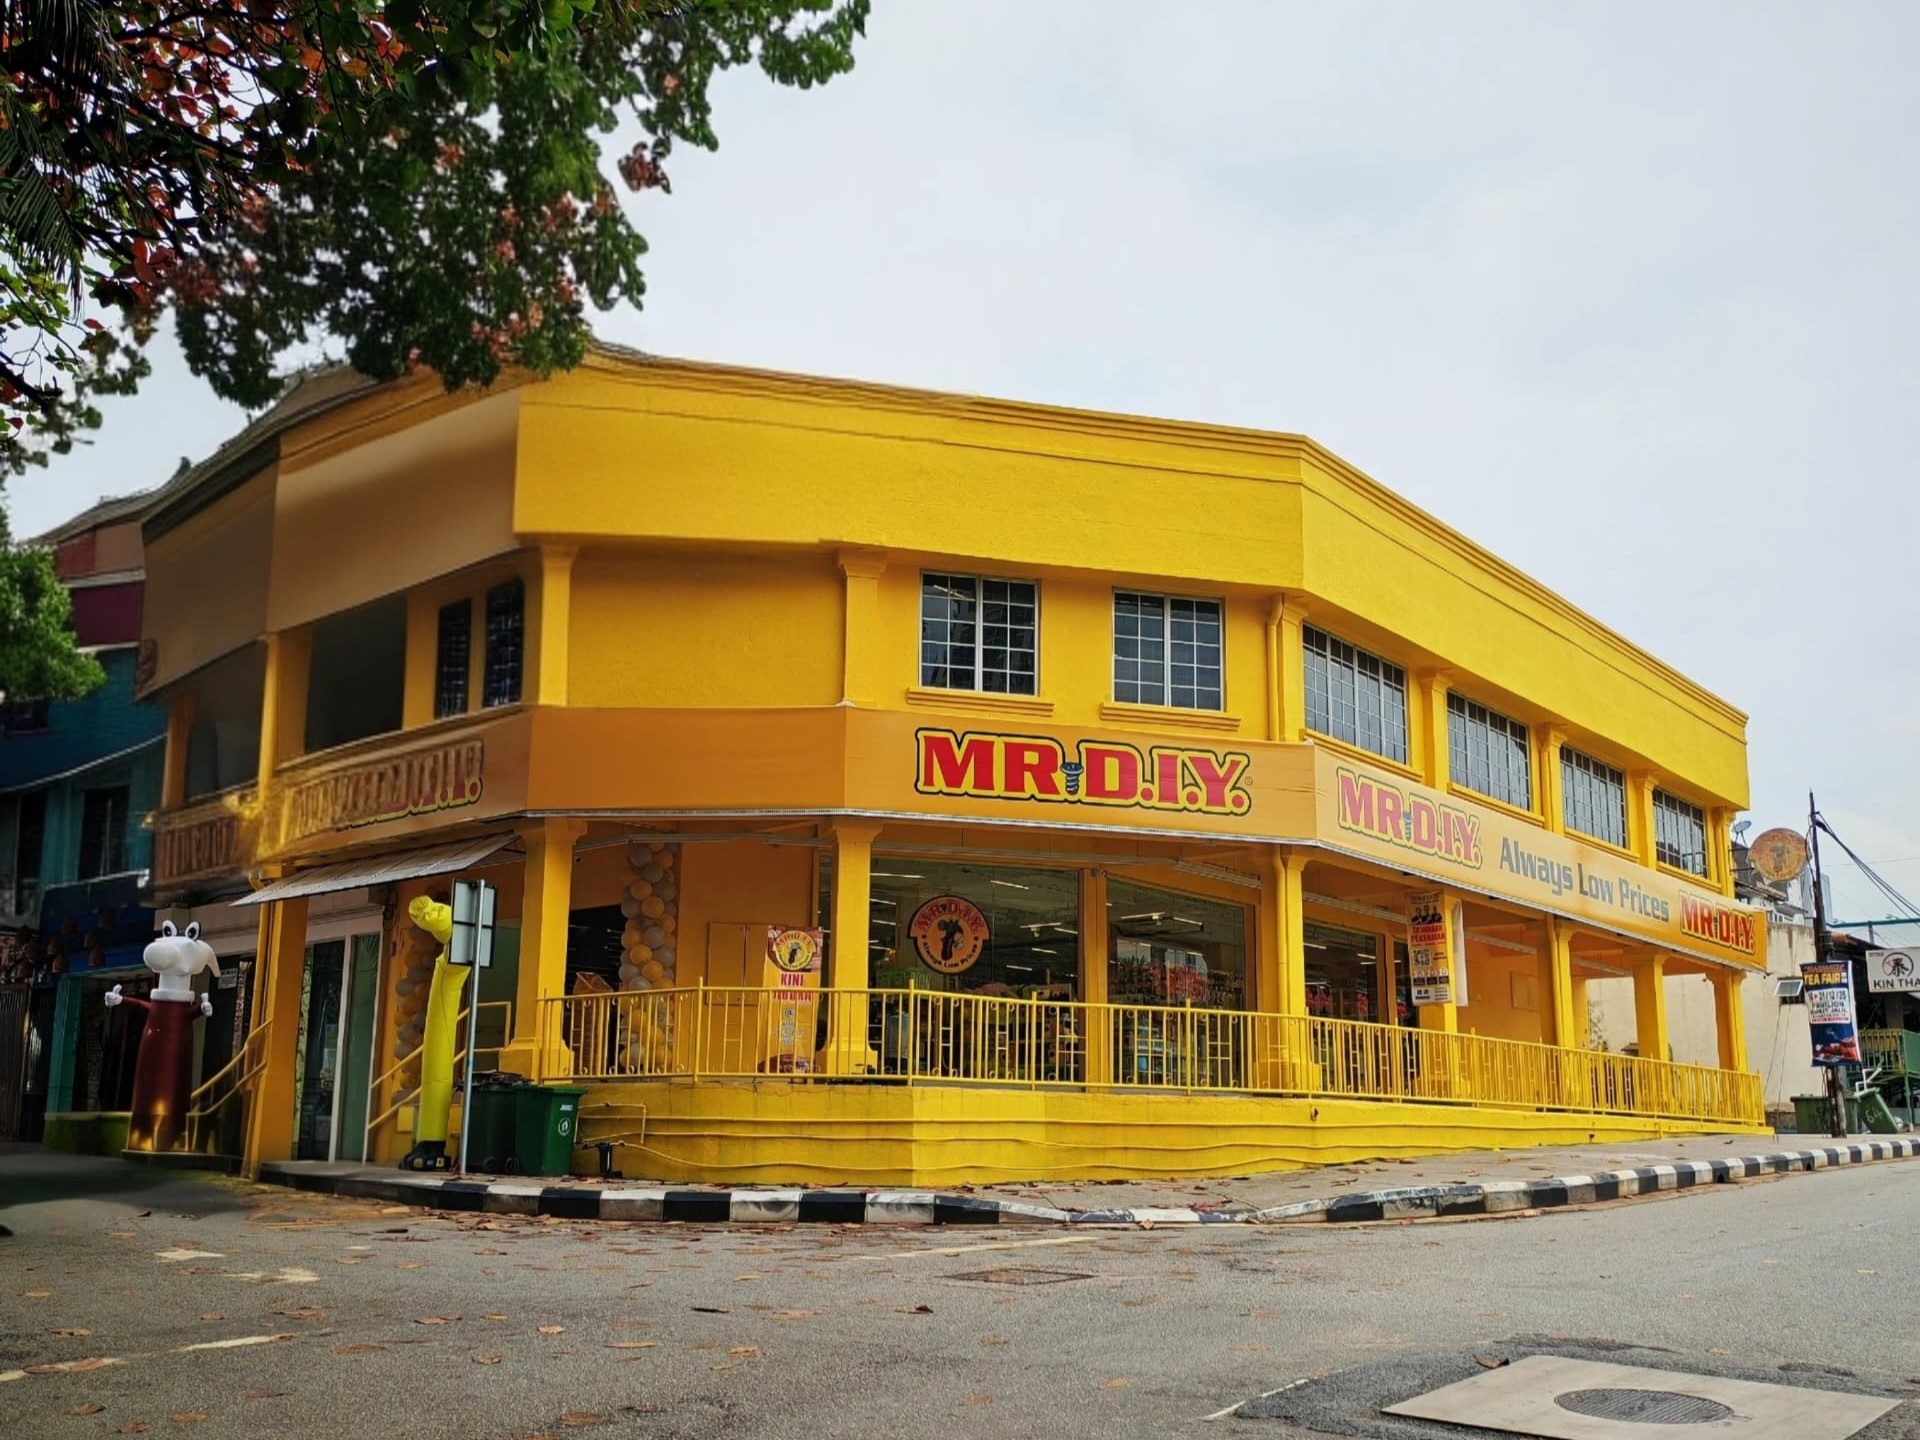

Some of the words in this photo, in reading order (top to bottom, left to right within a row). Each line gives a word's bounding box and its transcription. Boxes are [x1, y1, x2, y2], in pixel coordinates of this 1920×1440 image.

[1500, 836, 1573, 896] Always
[1578, 863, 1613, 904] Low
[1619, 877, 1669, 923] Prices
[780, 973, 804, 987] KINI
[1804, 973, 1820, 986] TEA
[1821, 972, 1841, 985] FAIR
[1873, 979, 1894, 989] KIN
